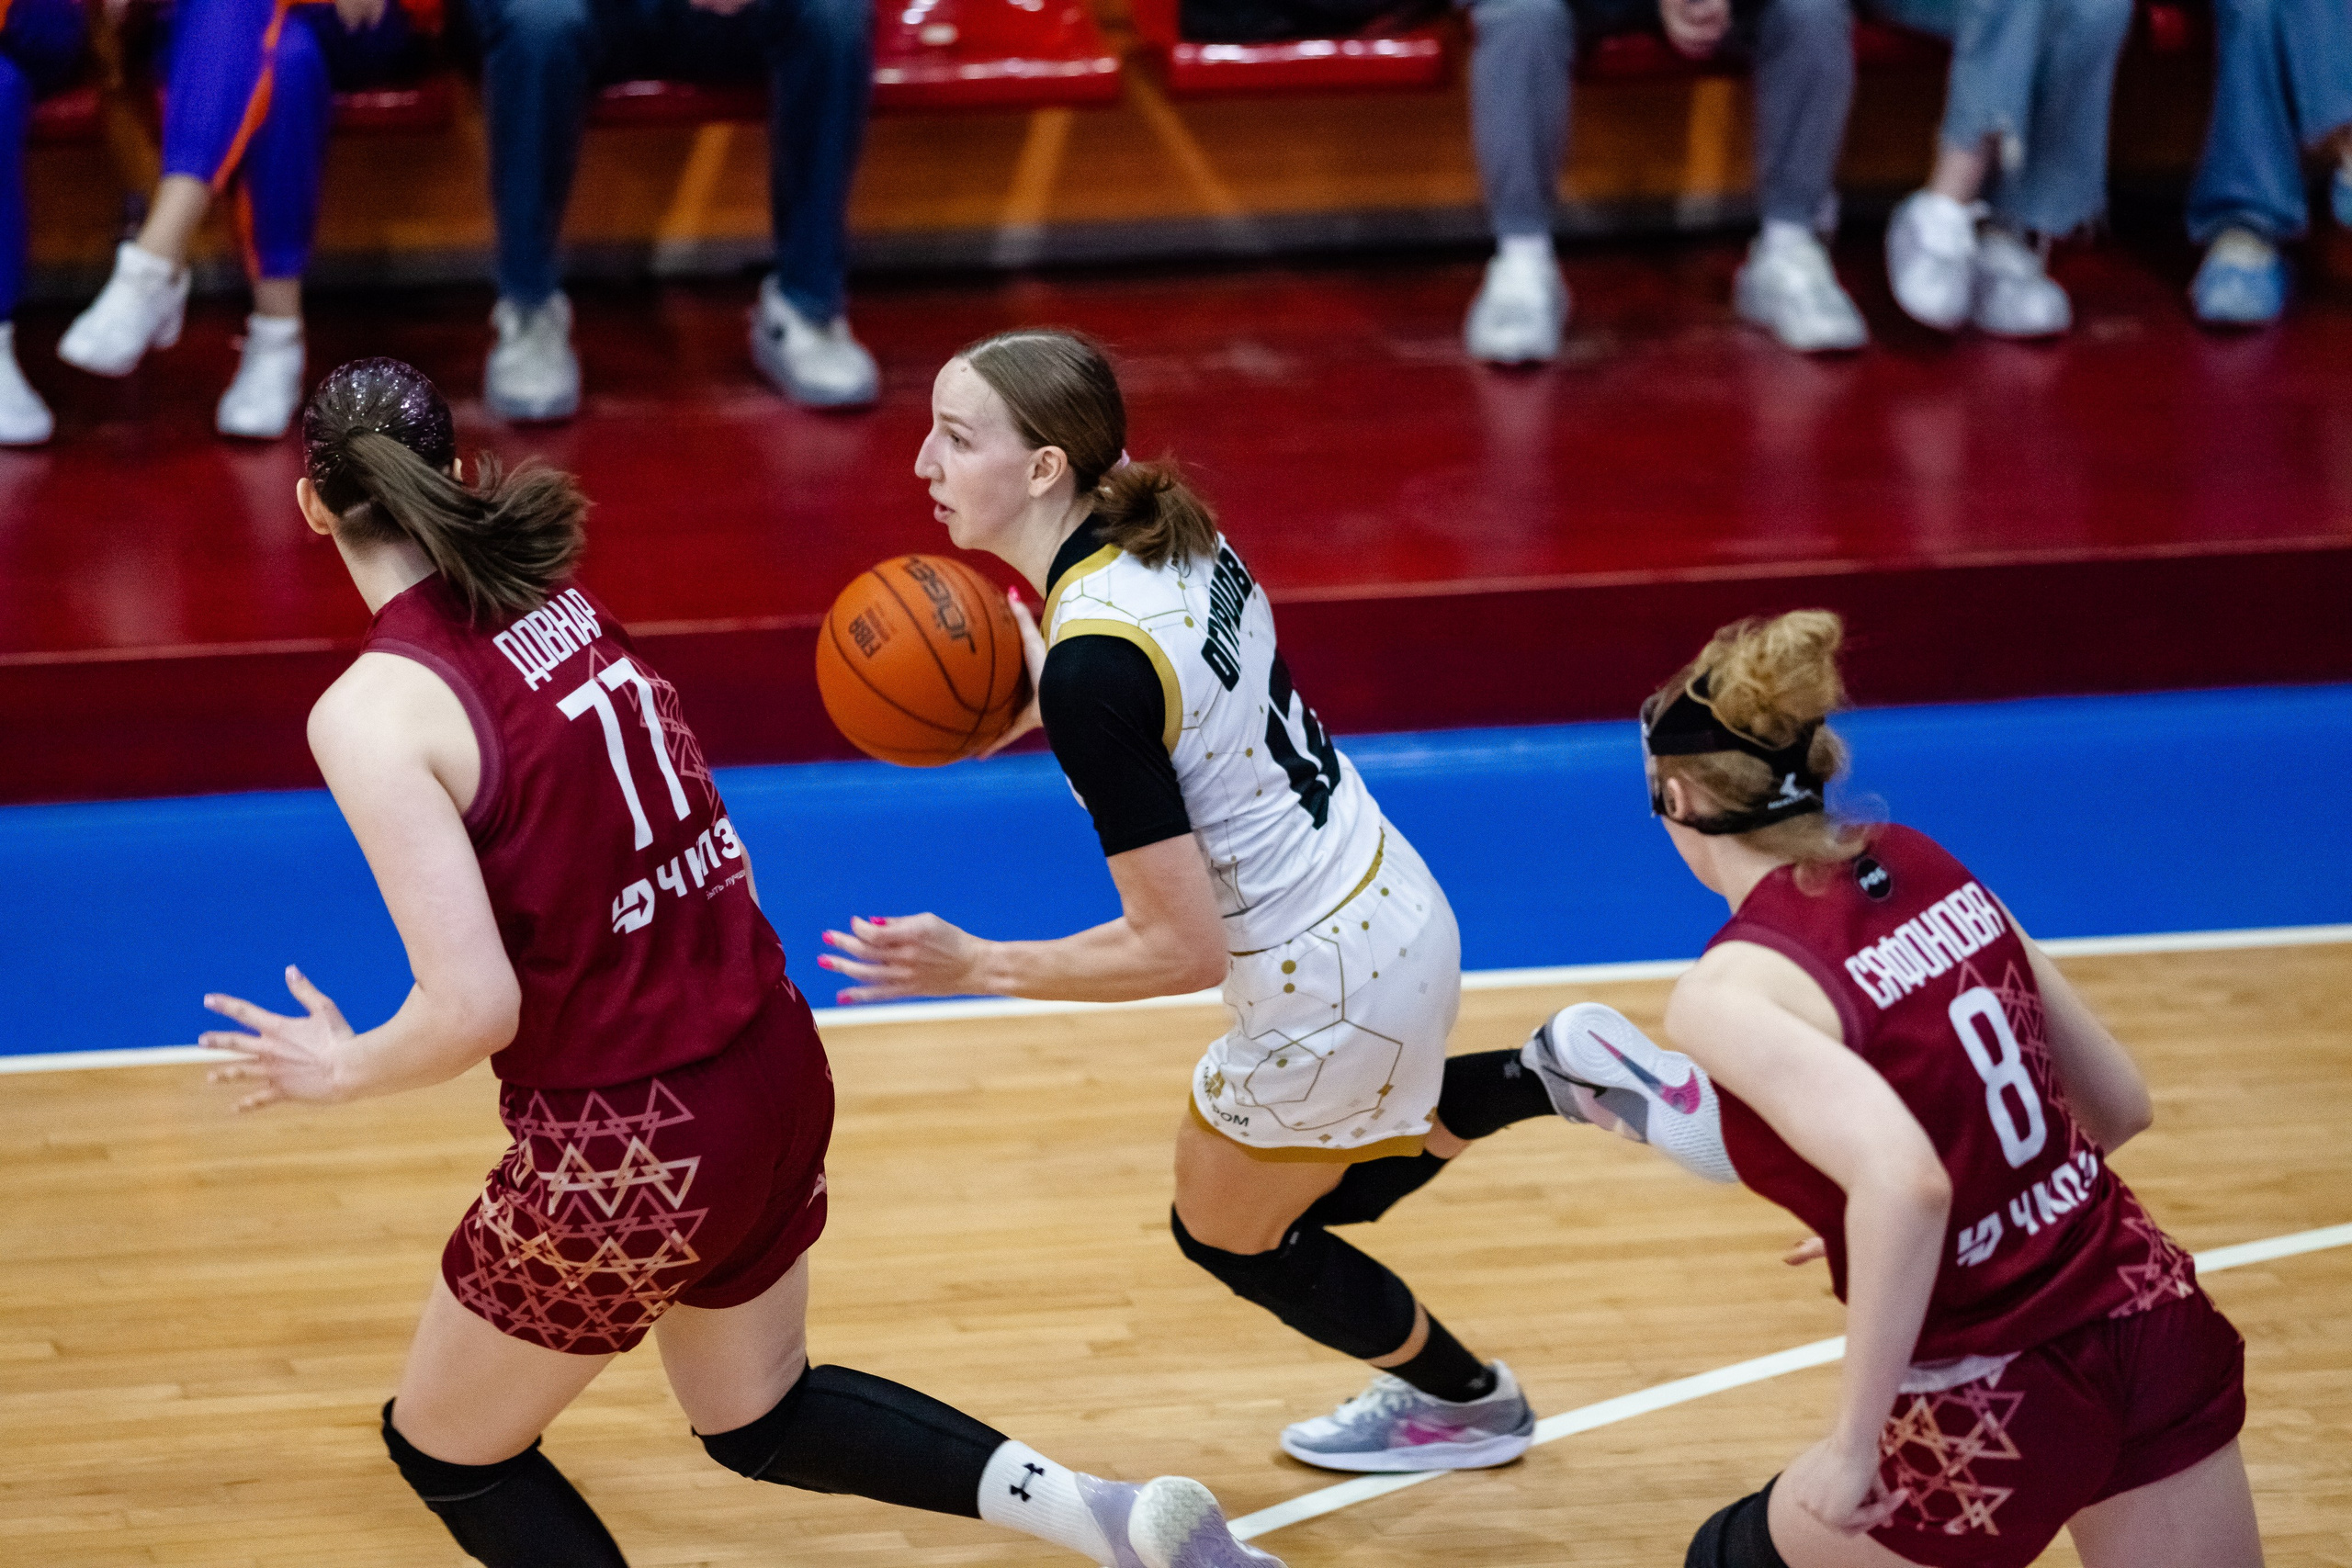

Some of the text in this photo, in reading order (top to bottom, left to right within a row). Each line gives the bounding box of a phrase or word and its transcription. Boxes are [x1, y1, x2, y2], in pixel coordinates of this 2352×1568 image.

[492, 588, 603, 692] ДОВНАР
[1201, 547, 1255, 693] ОГУРЦОВ
[556, 657, 691, 852] 77
[1844, 881, 2007, 1010] САФОНОВА
[1948, 986, 2048, 1169] 8
